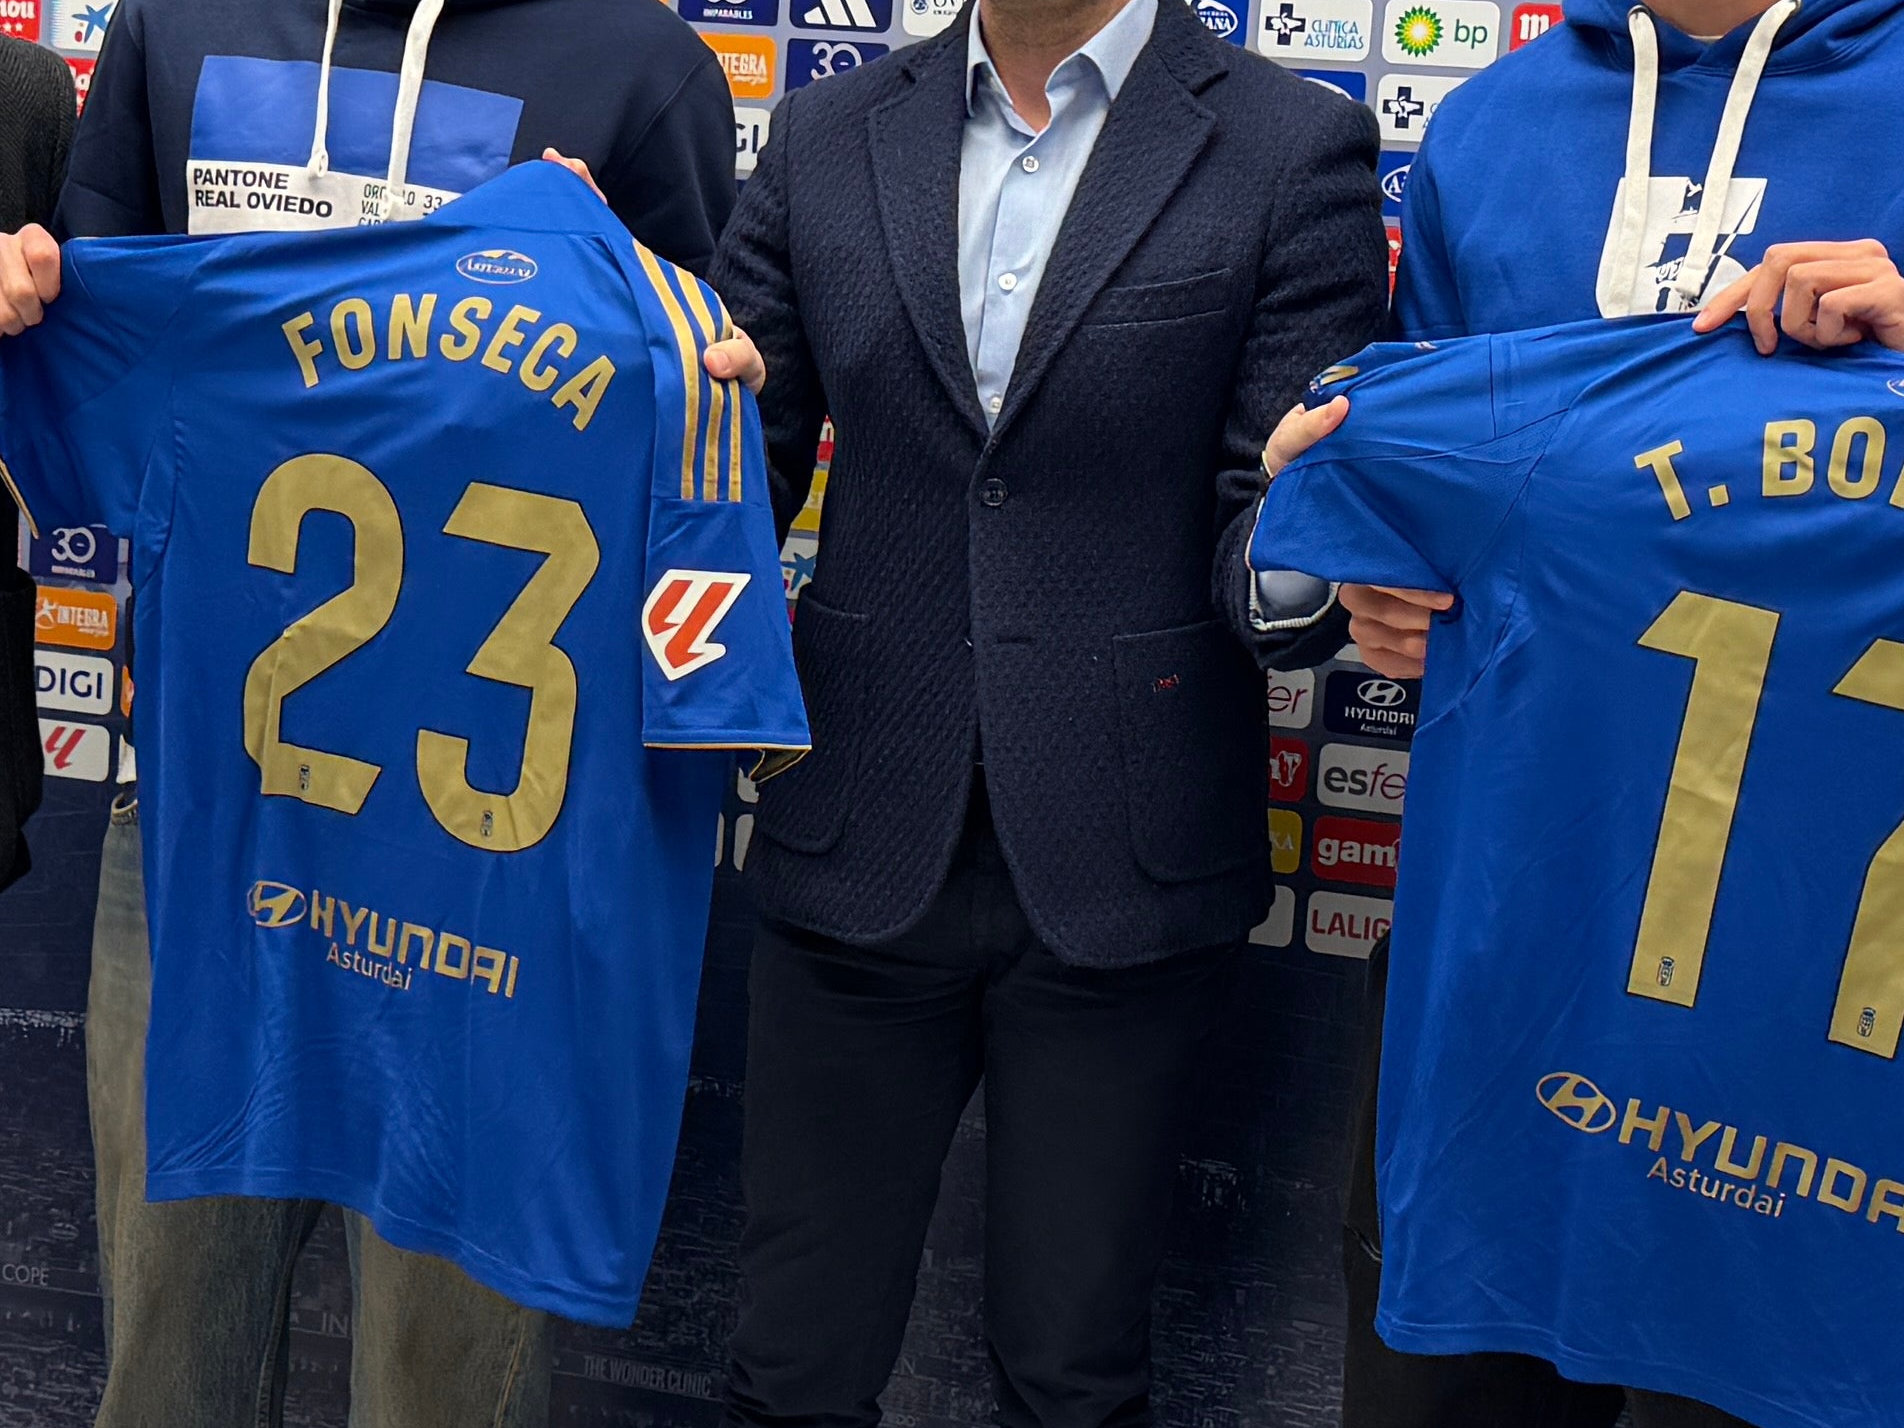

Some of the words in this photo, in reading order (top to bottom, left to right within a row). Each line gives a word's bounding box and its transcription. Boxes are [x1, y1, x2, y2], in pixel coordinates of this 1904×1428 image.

[194, 168, 290, 189] PANTONE
[196, 190, 240, 208] REAL
[247, 193, 332, 217] OVIEDO
[282, 293, 617, 432] FONSECA
[1635, 439, 1730, 522] T.
[244, 453, 601, 853] 23
[37, 664, 103, 700] DIGI
[1323, 763, 1407, 800] esfe
[310, 890, 519, 1000] HYUNDAI
[326, 943, 412, 992] Asturdai
[1647, 1156, 1785, 1219] Asturdai
[1, 1263, 49, 1287] COPE
[581, 1355, 606, 1379] THE
